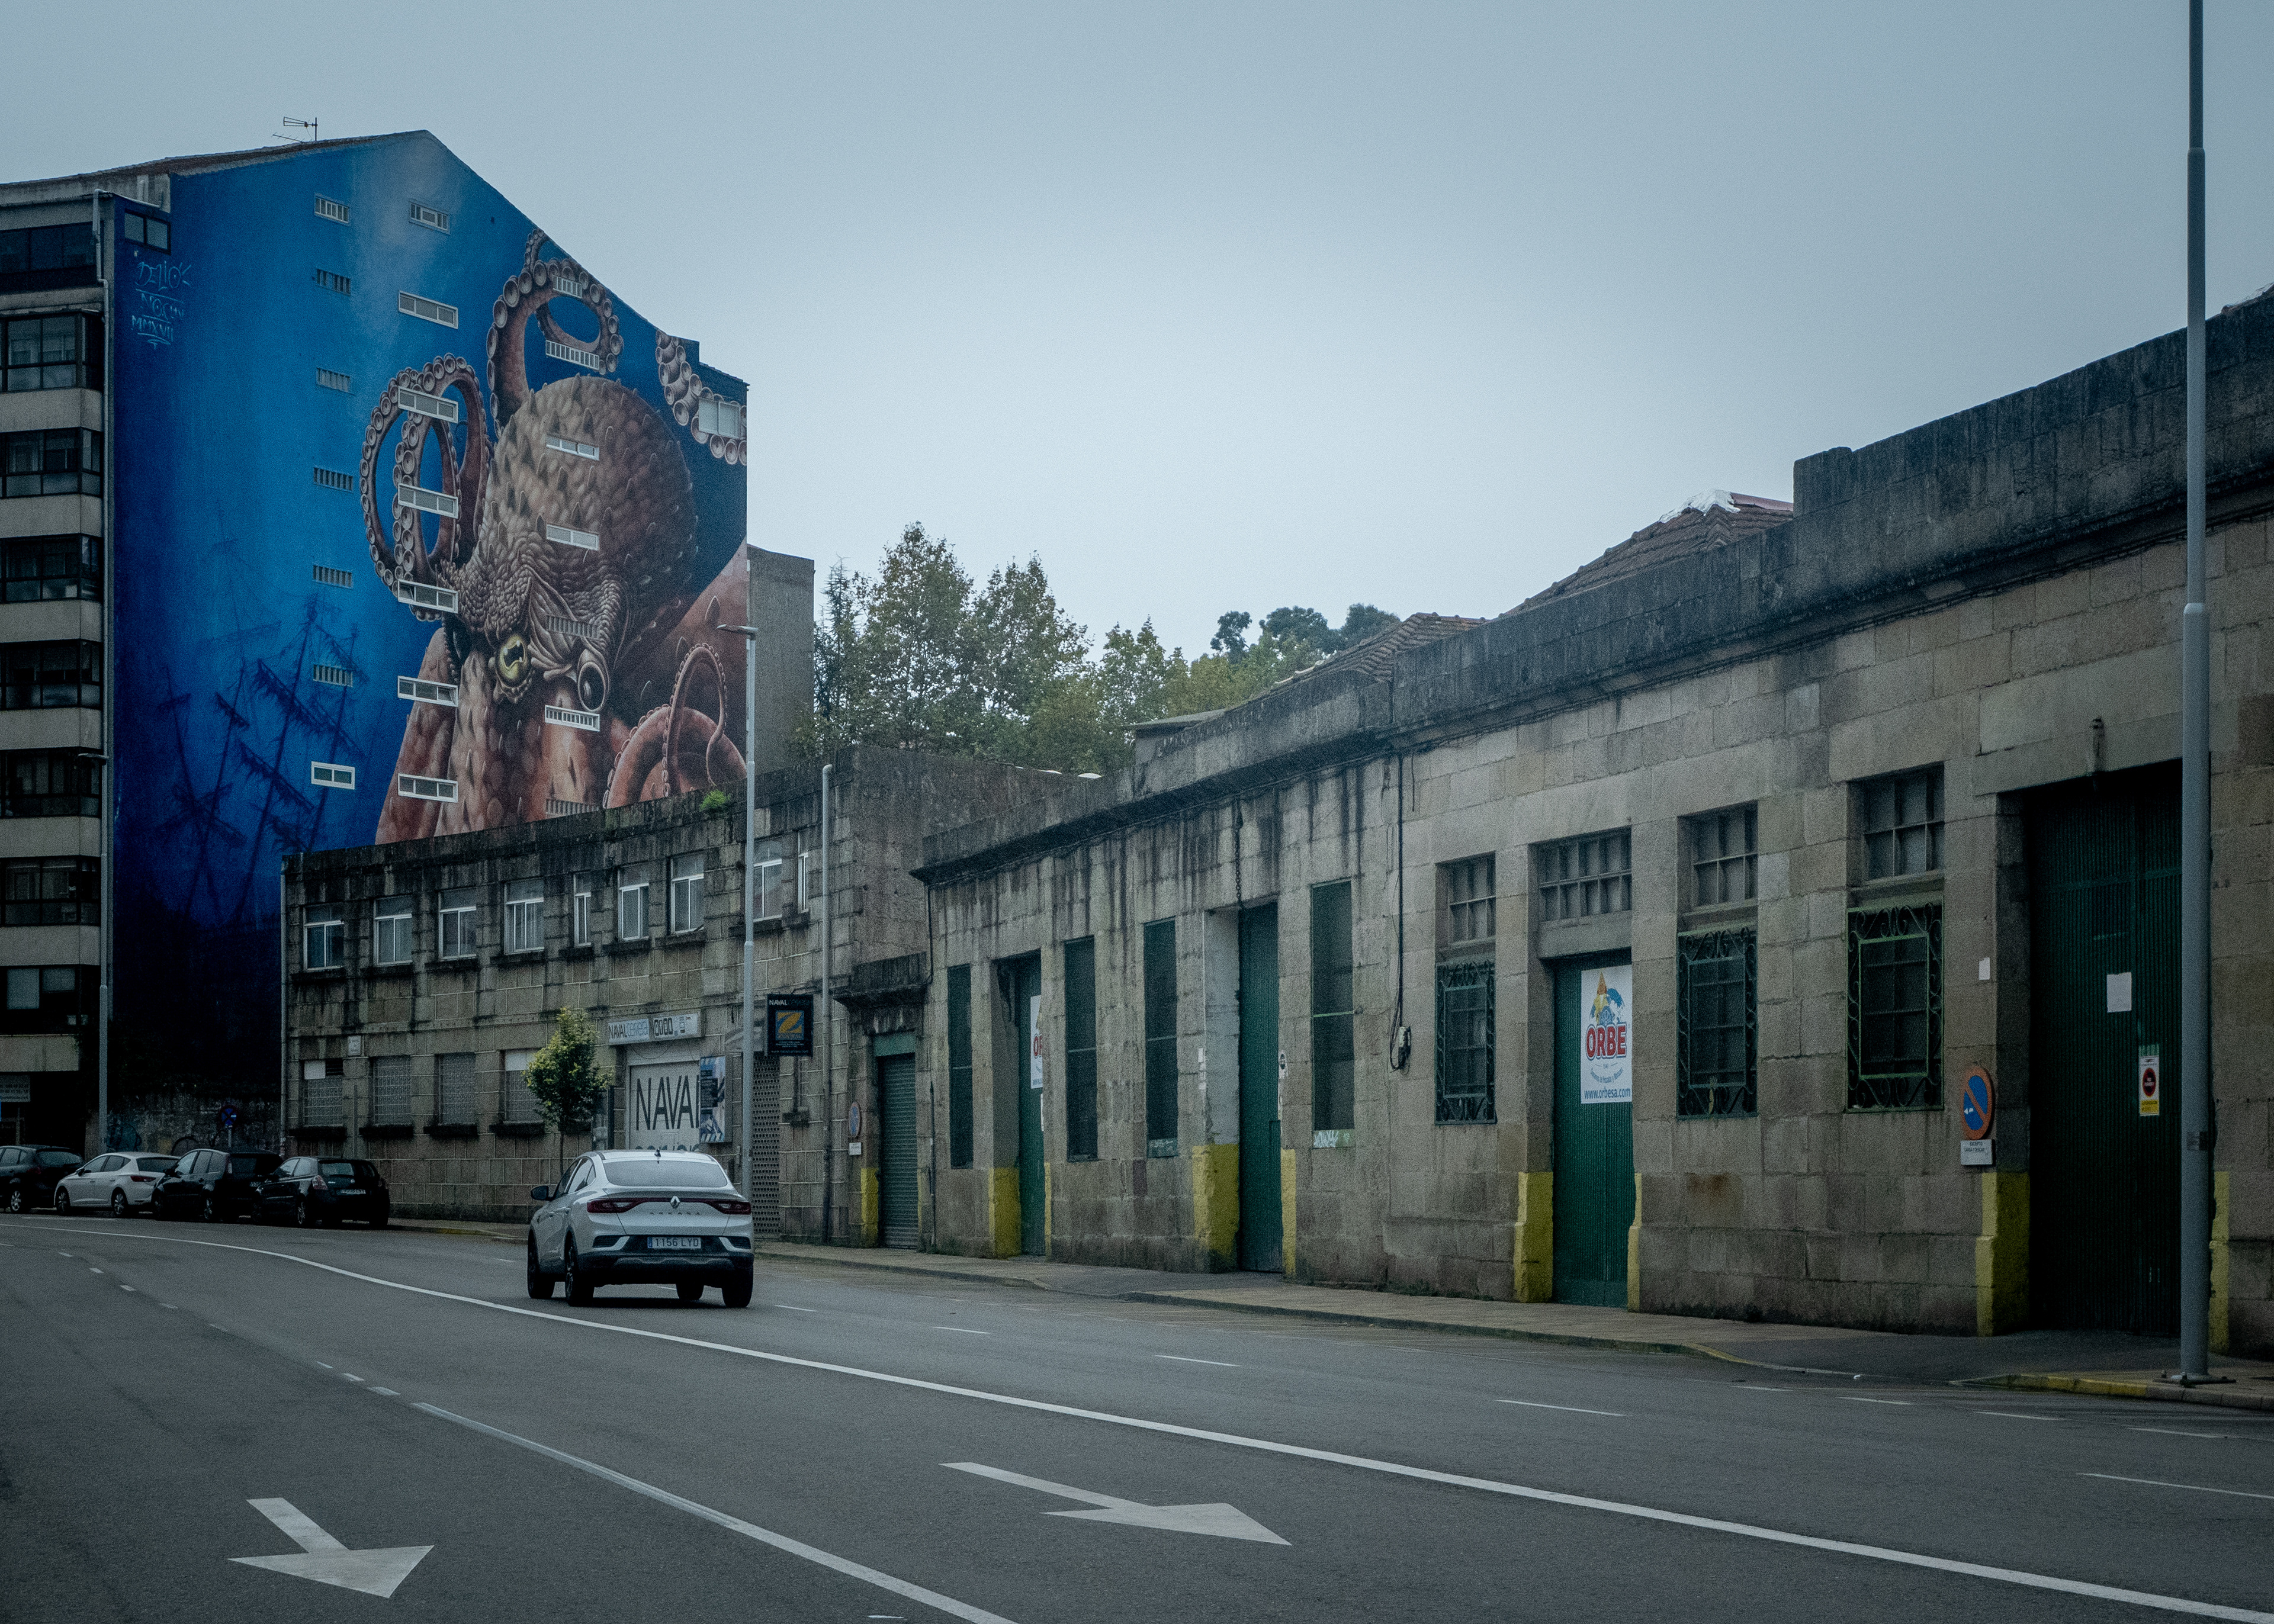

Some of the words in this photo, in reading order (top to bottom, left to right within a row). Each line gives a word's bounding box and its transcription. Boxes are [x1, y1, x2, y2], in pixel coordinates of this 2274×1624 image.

[1586, 1024, 1627, 1059] ORBE
[1584, 1086, 1631, 1099] www.orbesa.com
[656, 1238, 678, 1247] 1156
[681, 1238, 699, 1247] LYD
